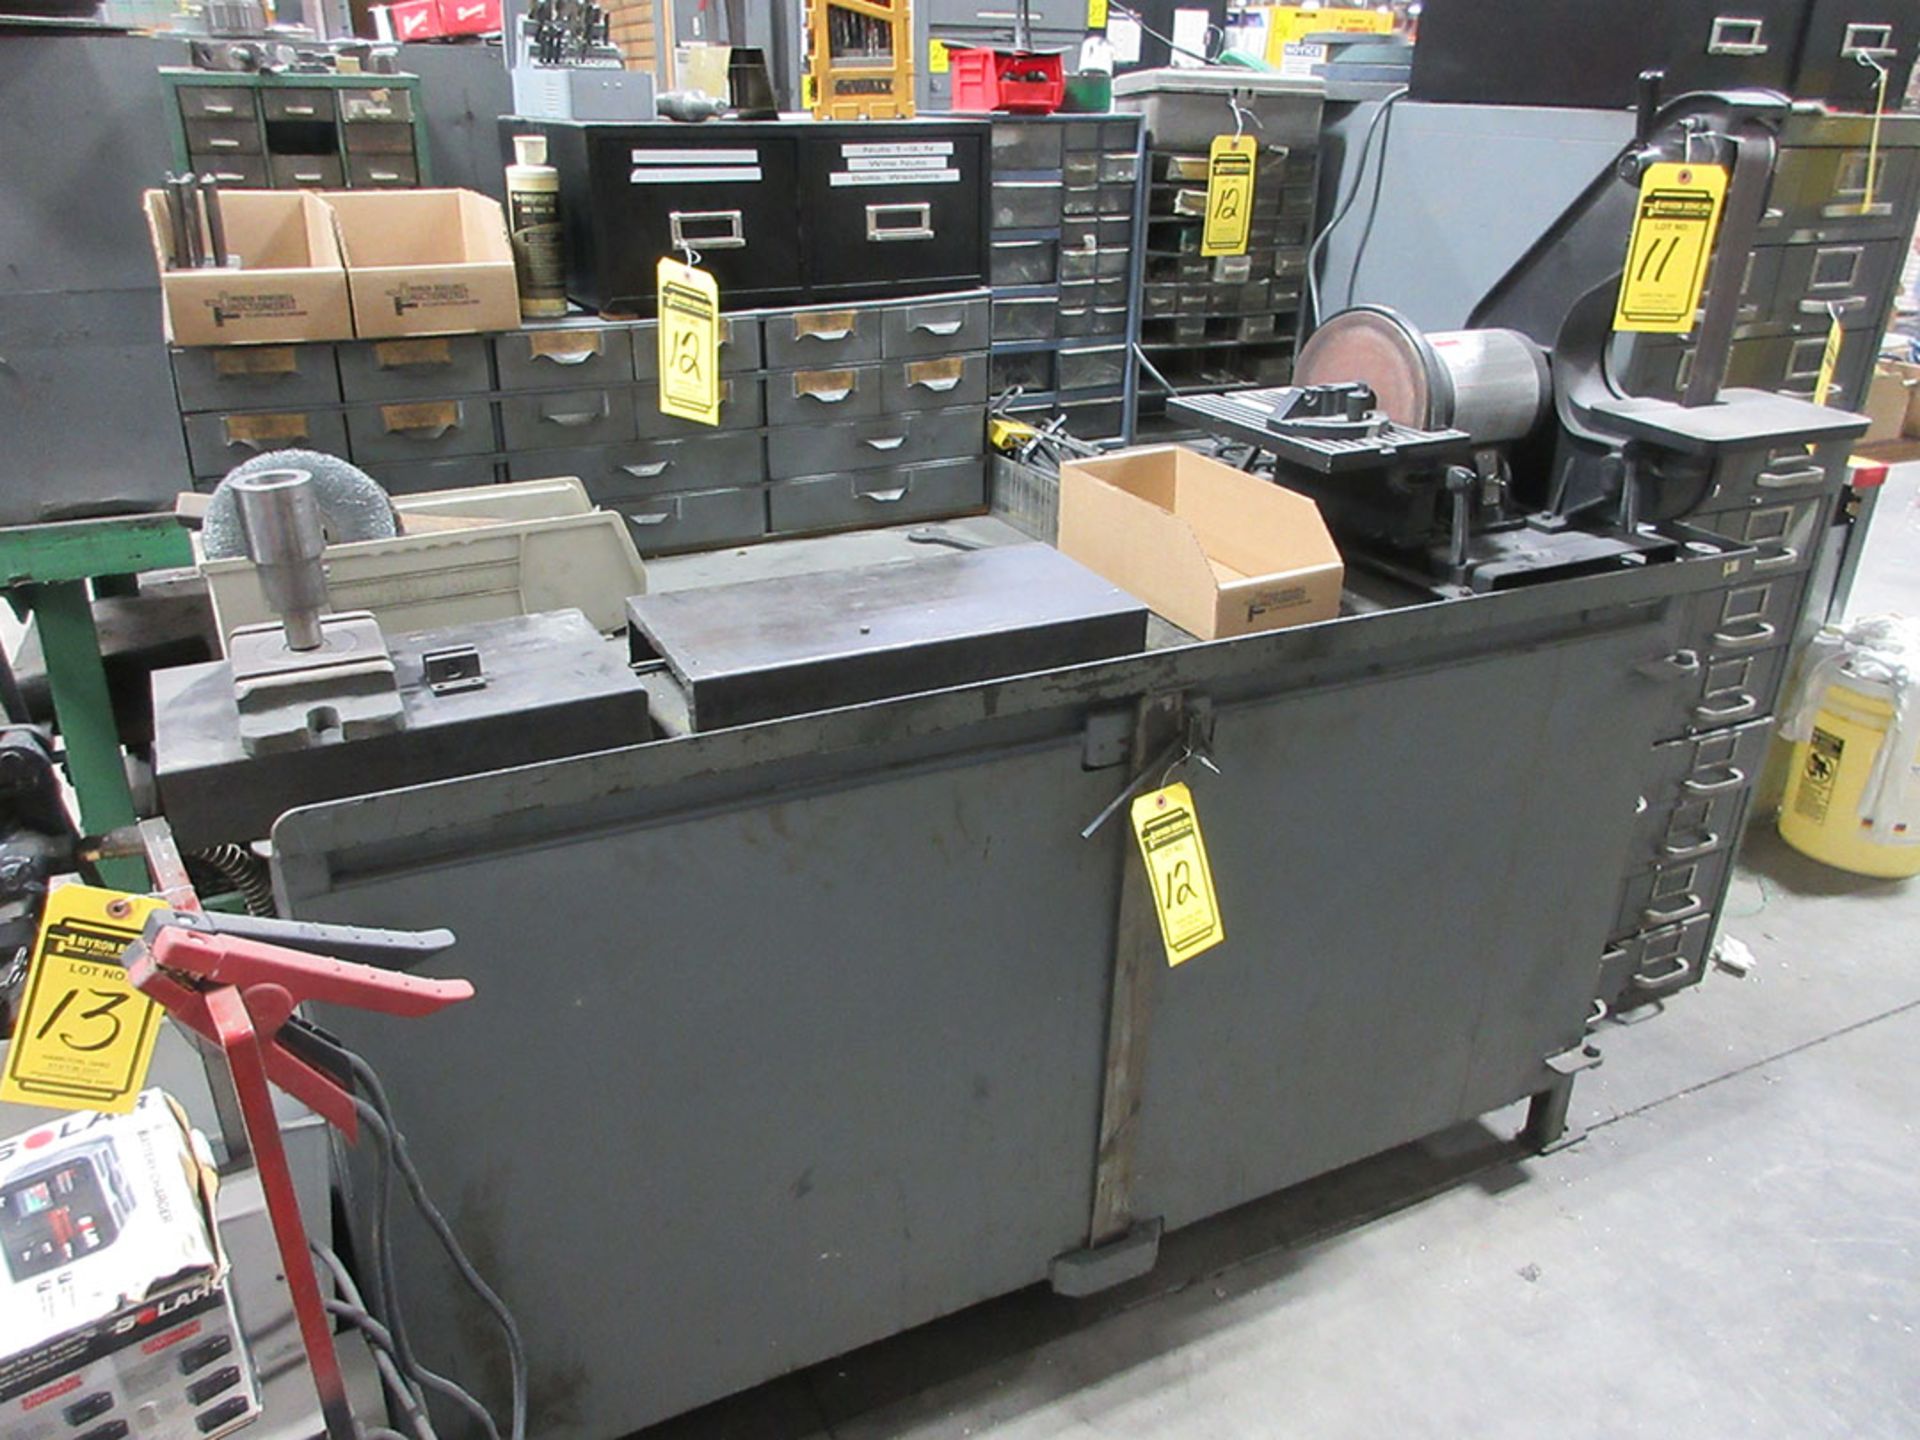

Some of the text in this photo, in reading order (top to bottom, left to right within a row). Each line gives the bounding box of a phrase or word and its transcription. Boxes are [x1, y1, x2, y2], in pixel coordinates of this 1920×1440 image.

[1213, 187, 1240, 220] 12
[1636, 236, 1681, 282] 11
[669, 330, 702, 382] 12
[1166, 860, 1198, 909] 12
[77, 934, 116, 954] MYRON
[69, 963, 98, 978] LOT
[35, 987, 131, 1052] 13
